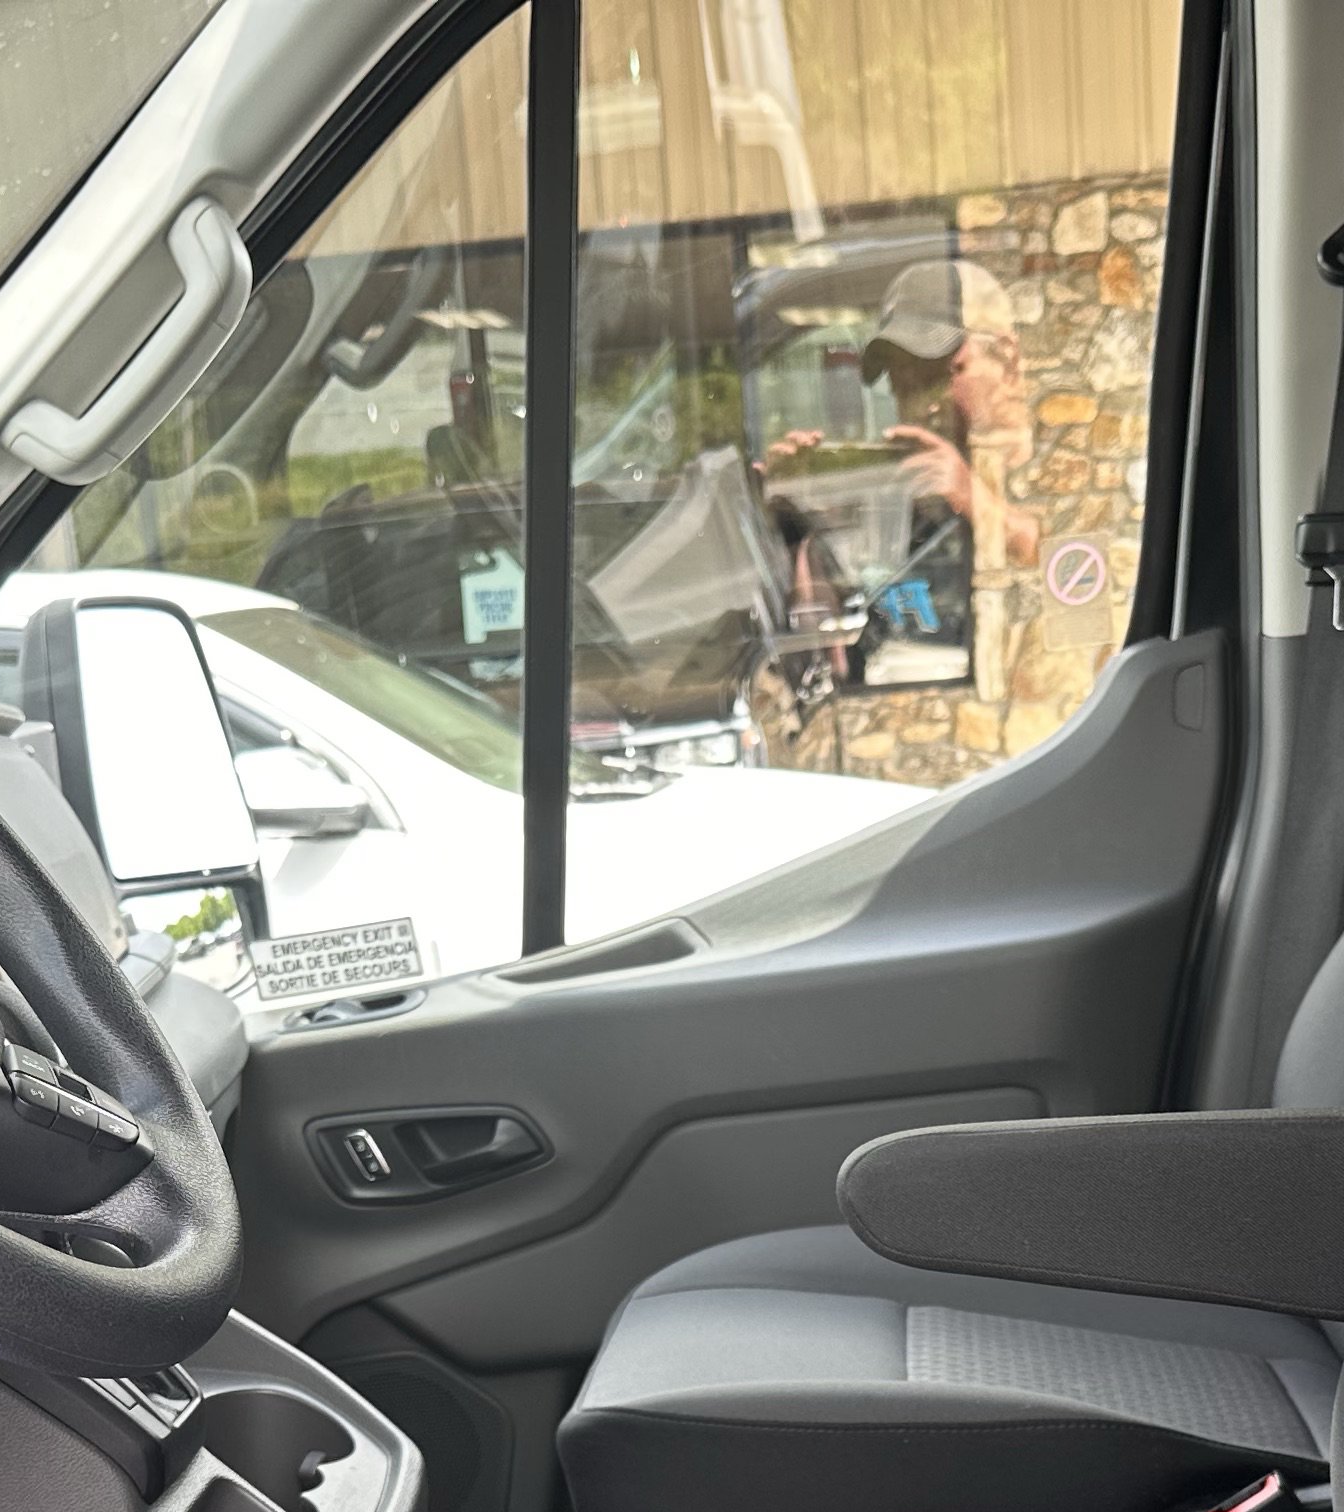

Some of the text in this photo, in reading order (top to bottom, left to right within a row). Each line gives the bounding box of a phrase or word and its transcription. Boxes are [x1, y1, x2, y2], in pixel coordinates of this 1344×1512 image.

[256, 941, 416, 978] SALIDA DE EMERGENCIA
[272, 926, 392, 959] EMERGENCY EXIT
[269, 959, 411, 994] SORTIE DE SECOURS
